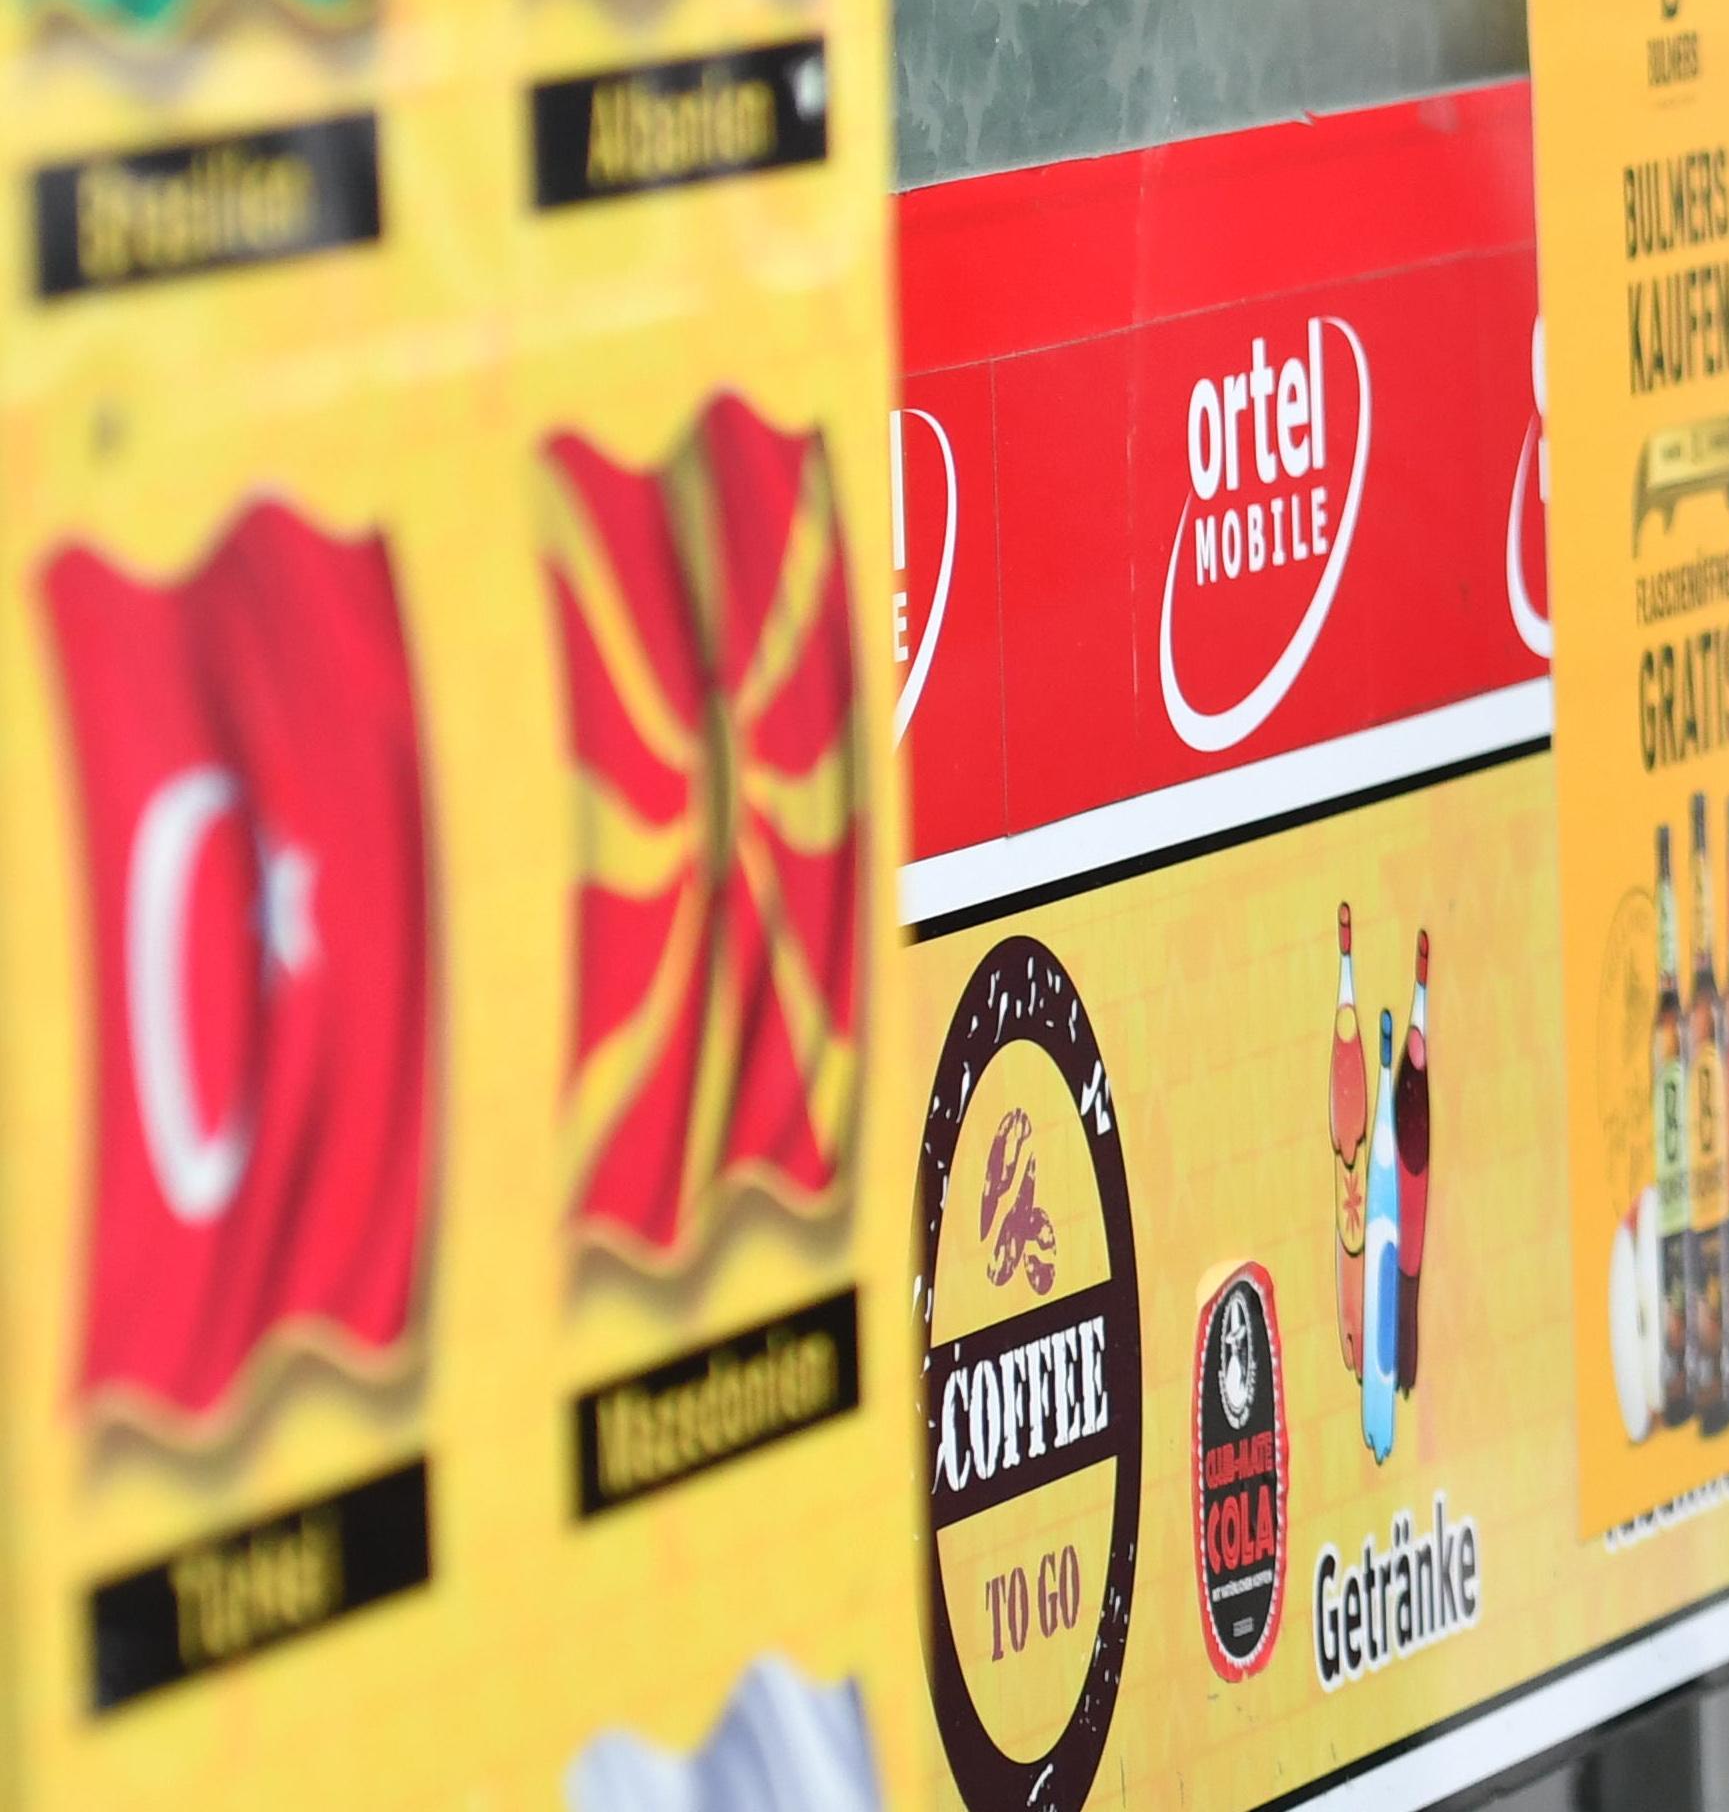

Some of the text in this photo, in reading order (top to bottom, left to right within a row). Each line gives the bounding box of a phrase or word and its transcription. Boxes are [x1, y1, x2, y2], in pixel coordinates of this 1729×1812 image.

[1647, 31, 1698, 87] BULMERS
[587, 78, 776, 185] Albanien
[1624, 146, 1729, 260] BULMERS
[1188, 317, 1325, 500] ortel
[1195, 486, 1328, 585] MOBILE
[934, 1316, 1108, 1493] COFFEE
[1207, 1485, 1275, 1574] COLA
[986, 1545, 1080, 1662] TO GO
[1316, 1501, 1476, 1682] Getränke
